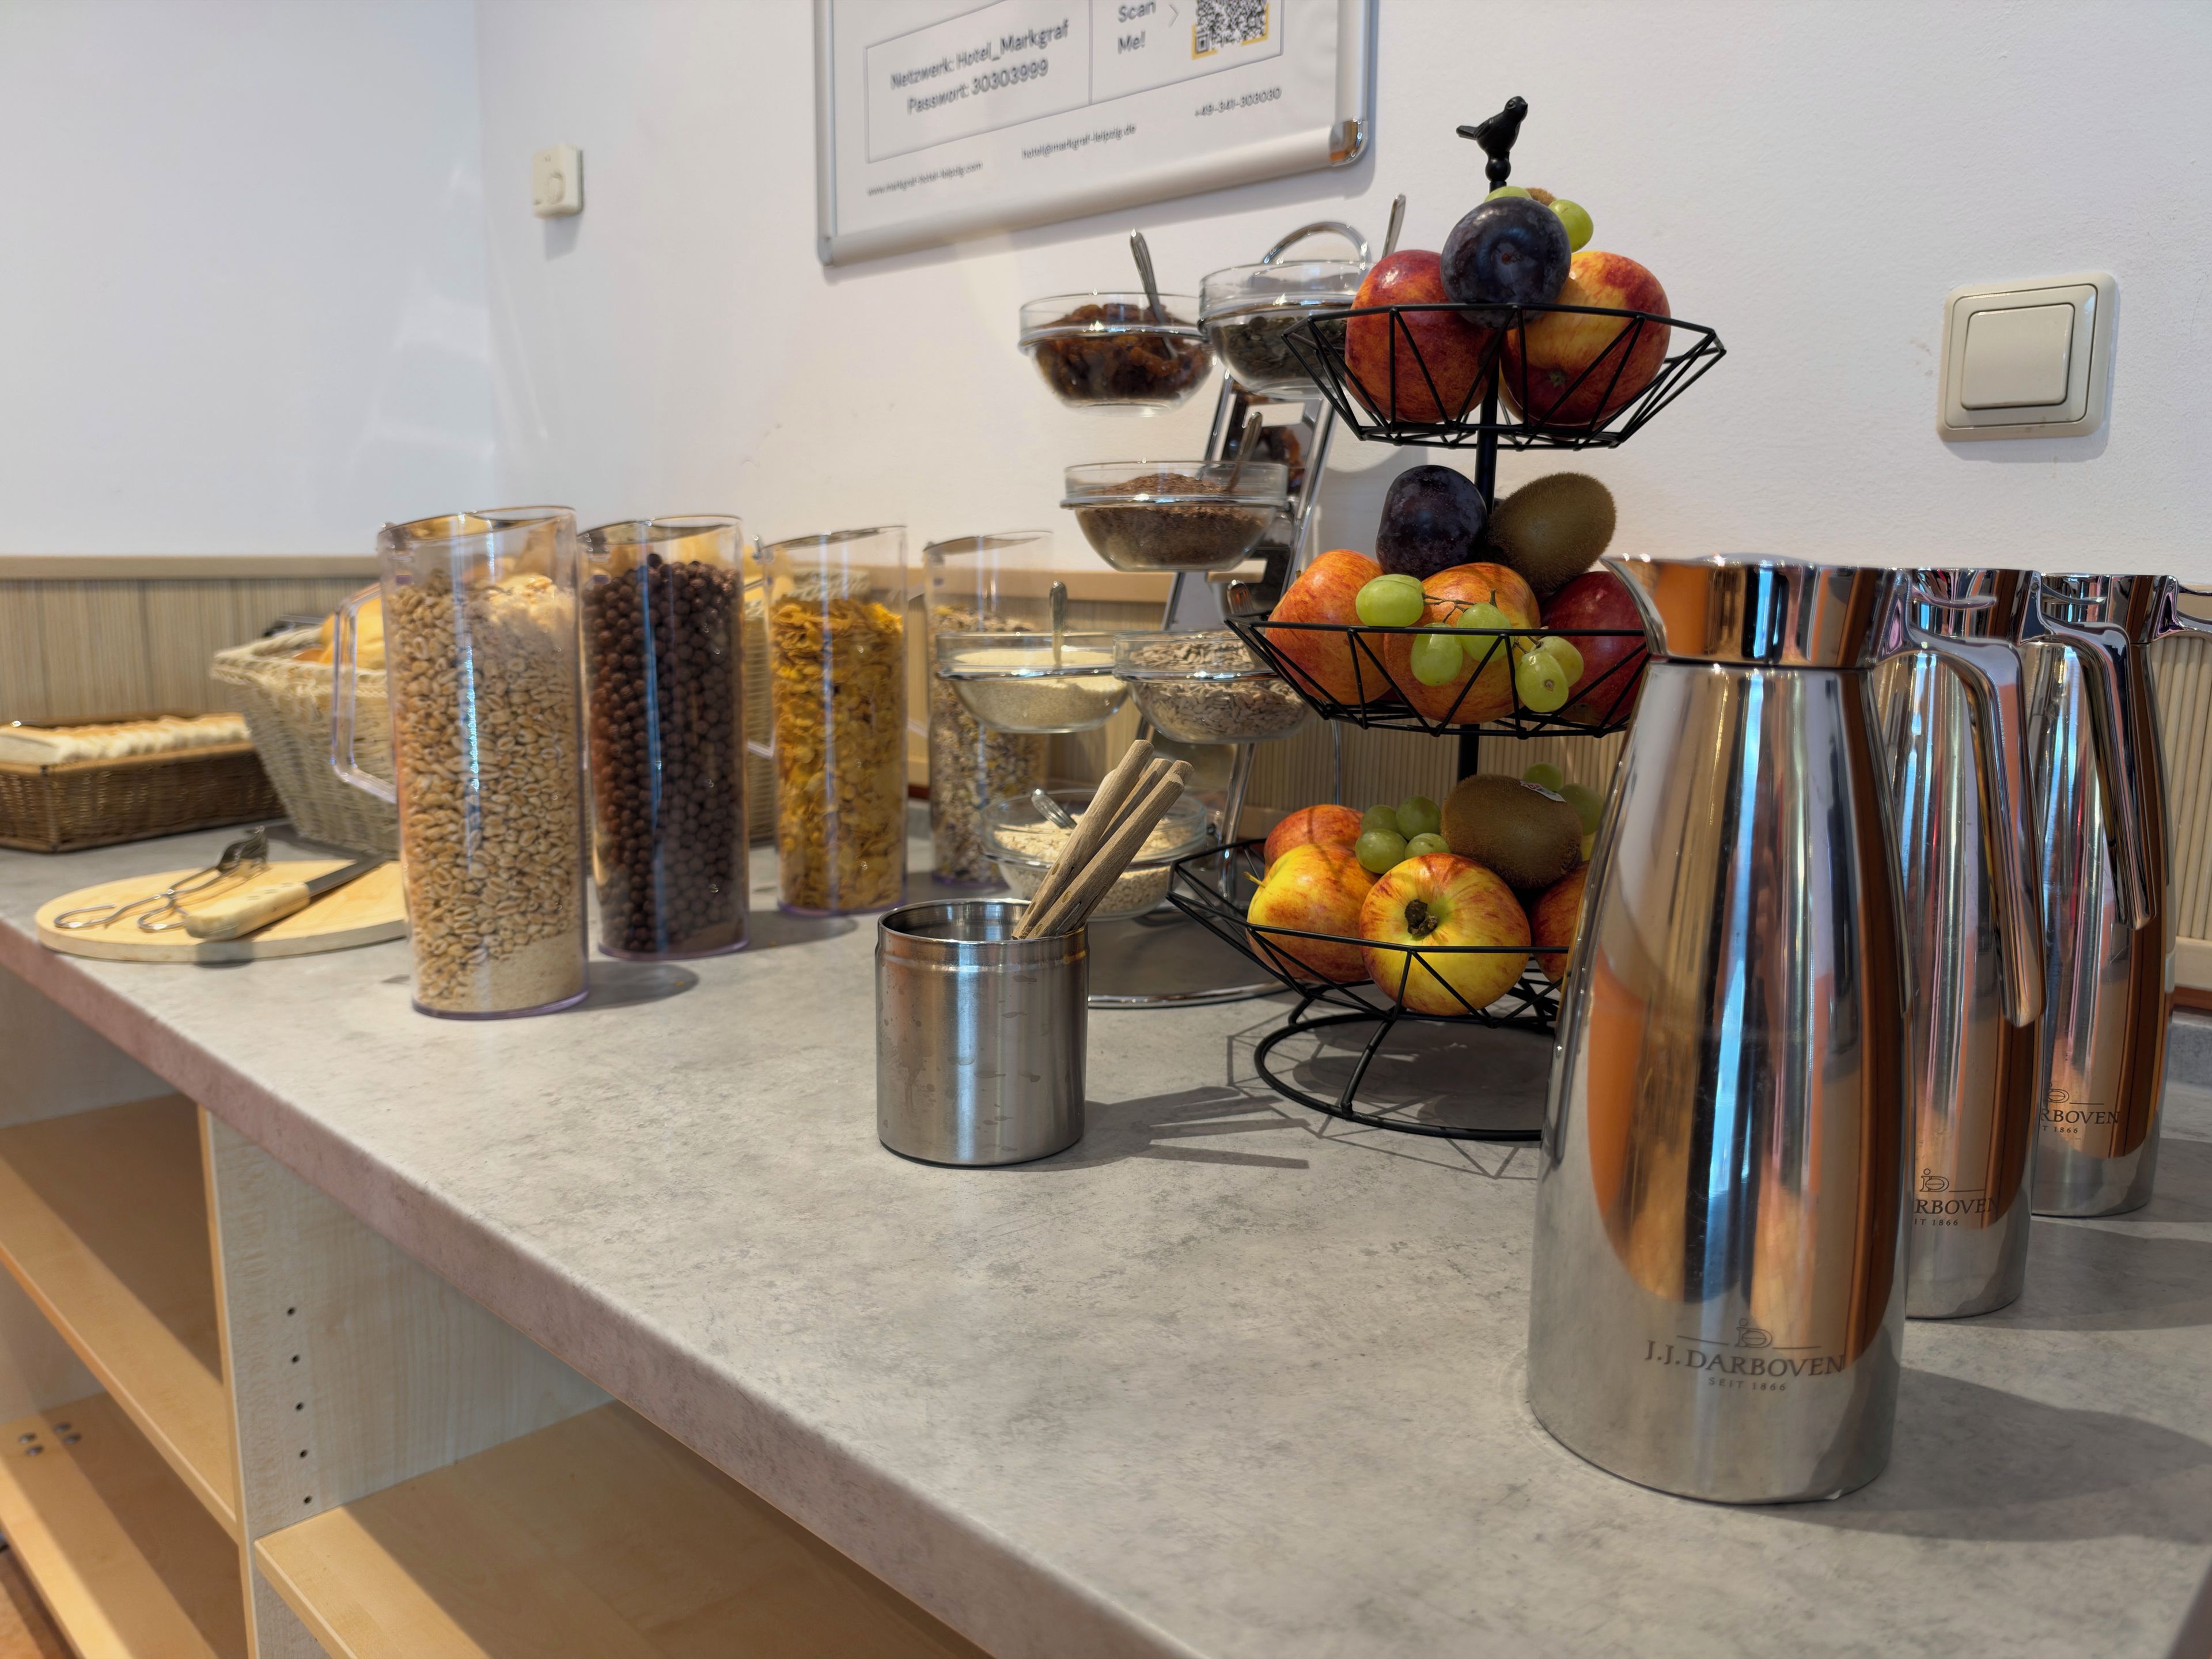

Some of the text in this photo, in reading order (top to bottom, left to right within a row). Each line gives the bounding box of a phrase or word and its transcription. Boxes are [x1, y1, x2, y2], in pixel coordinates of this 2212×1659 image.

[1118, 1, 1156, 22] Scan
[891, 18, 1069, 89] Netzwerk: Hotel_Markgraf
[1118, 31, 1146, 54] Me!
[907, 58, 1048, 115] Passwort: 30303999
[1645, 1339, 1844, 1377] J.J. DARBOVEN
[1708, 1376, 1786, 1392] SEIT 1866
